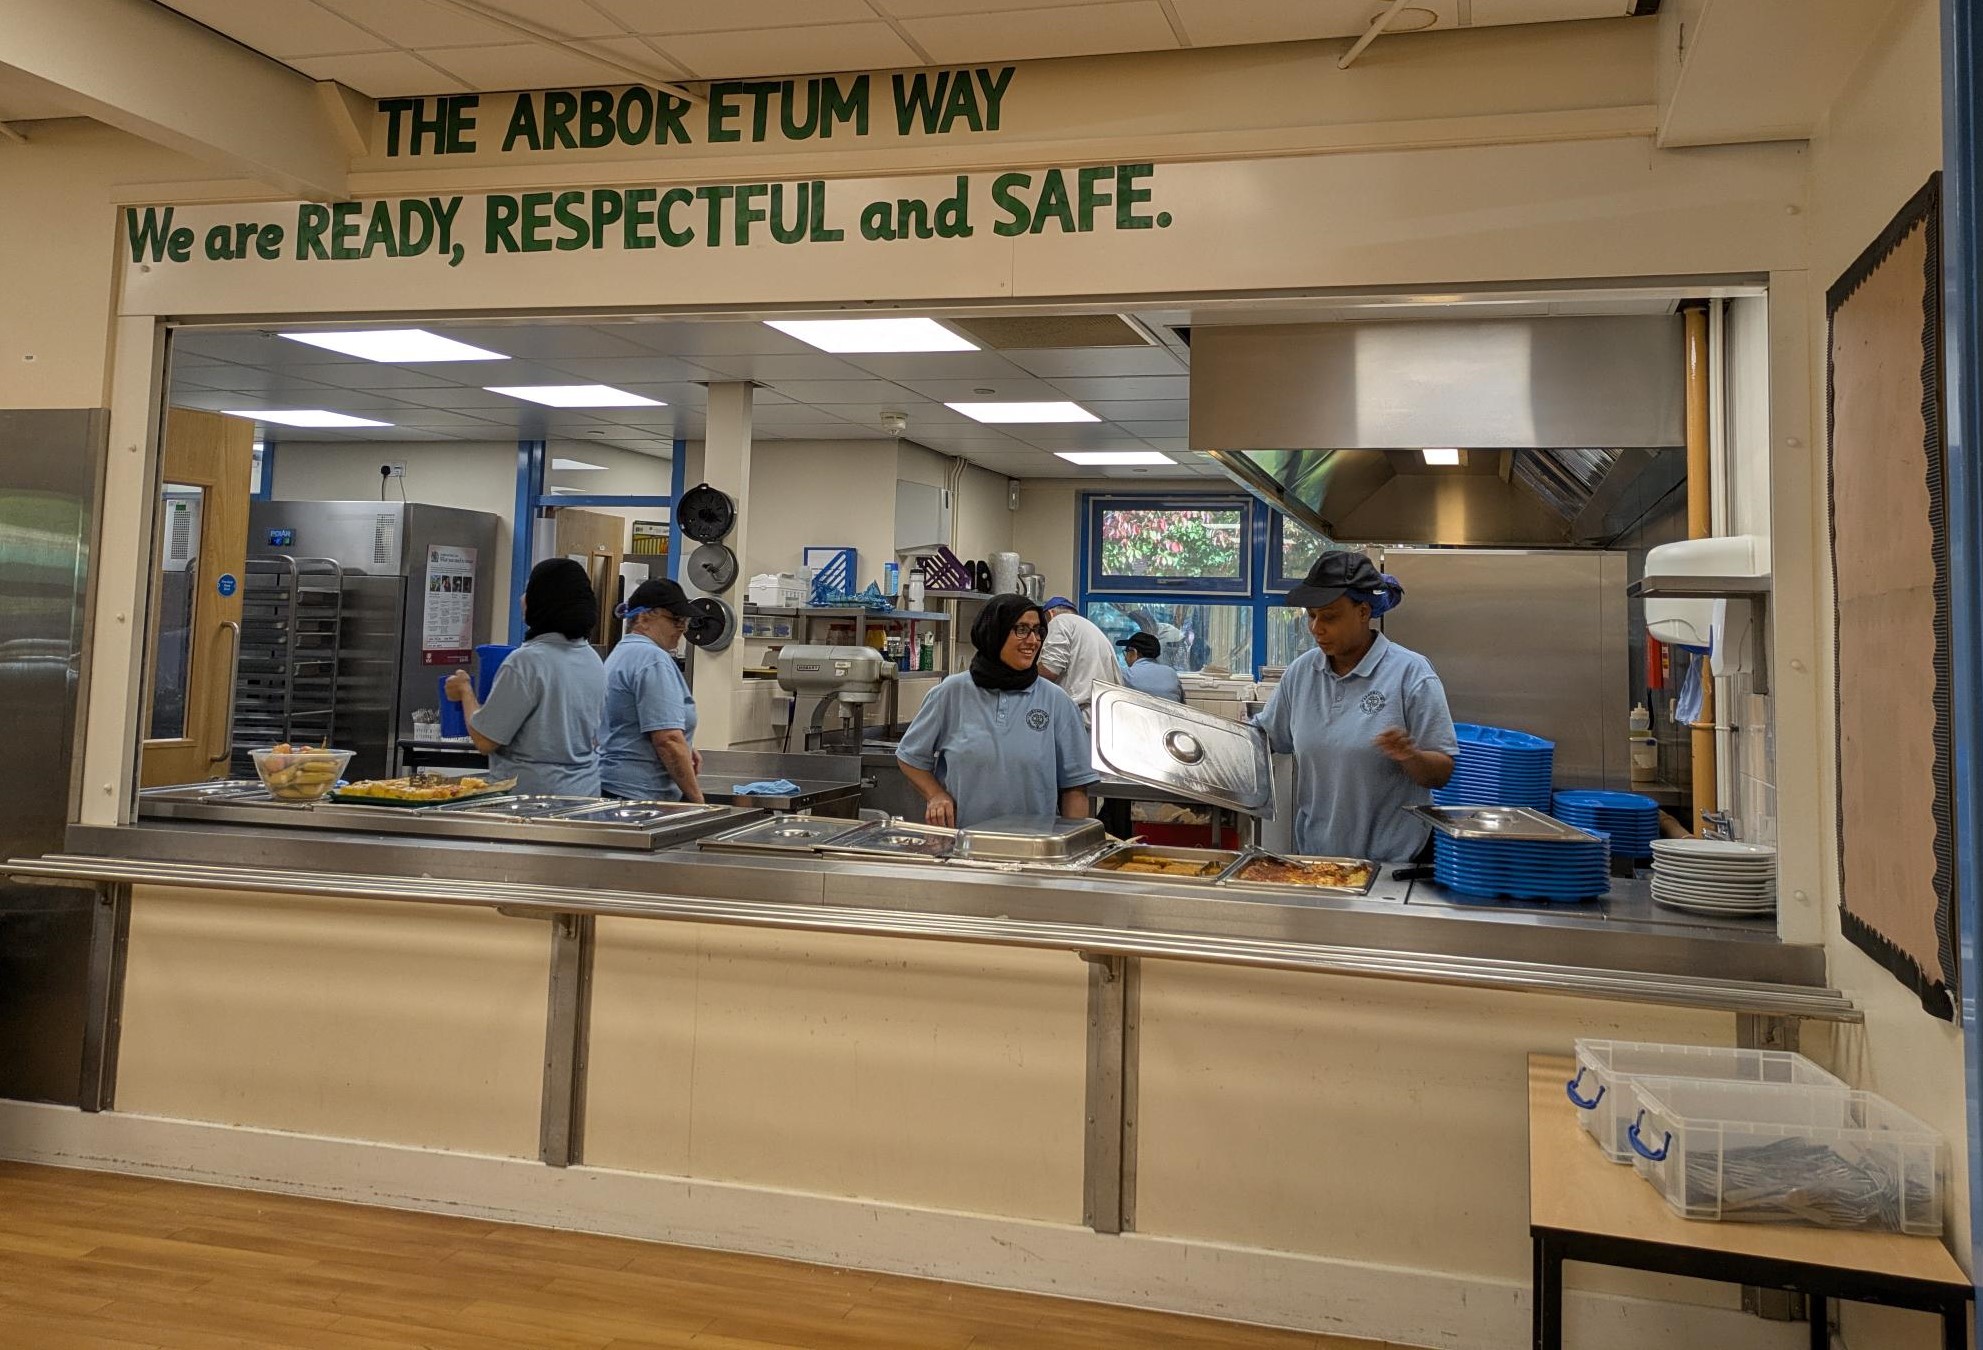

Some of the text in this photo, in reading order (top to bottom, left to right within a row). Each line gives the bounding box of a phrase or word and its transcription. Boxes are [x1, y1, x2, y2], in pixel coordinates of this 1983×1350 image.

[380, 68, 1015, 156] THE ARBOR ETUM WAY
[126, 164, 1173, 267] We are READY, RESPECTFUL and SAFE.
